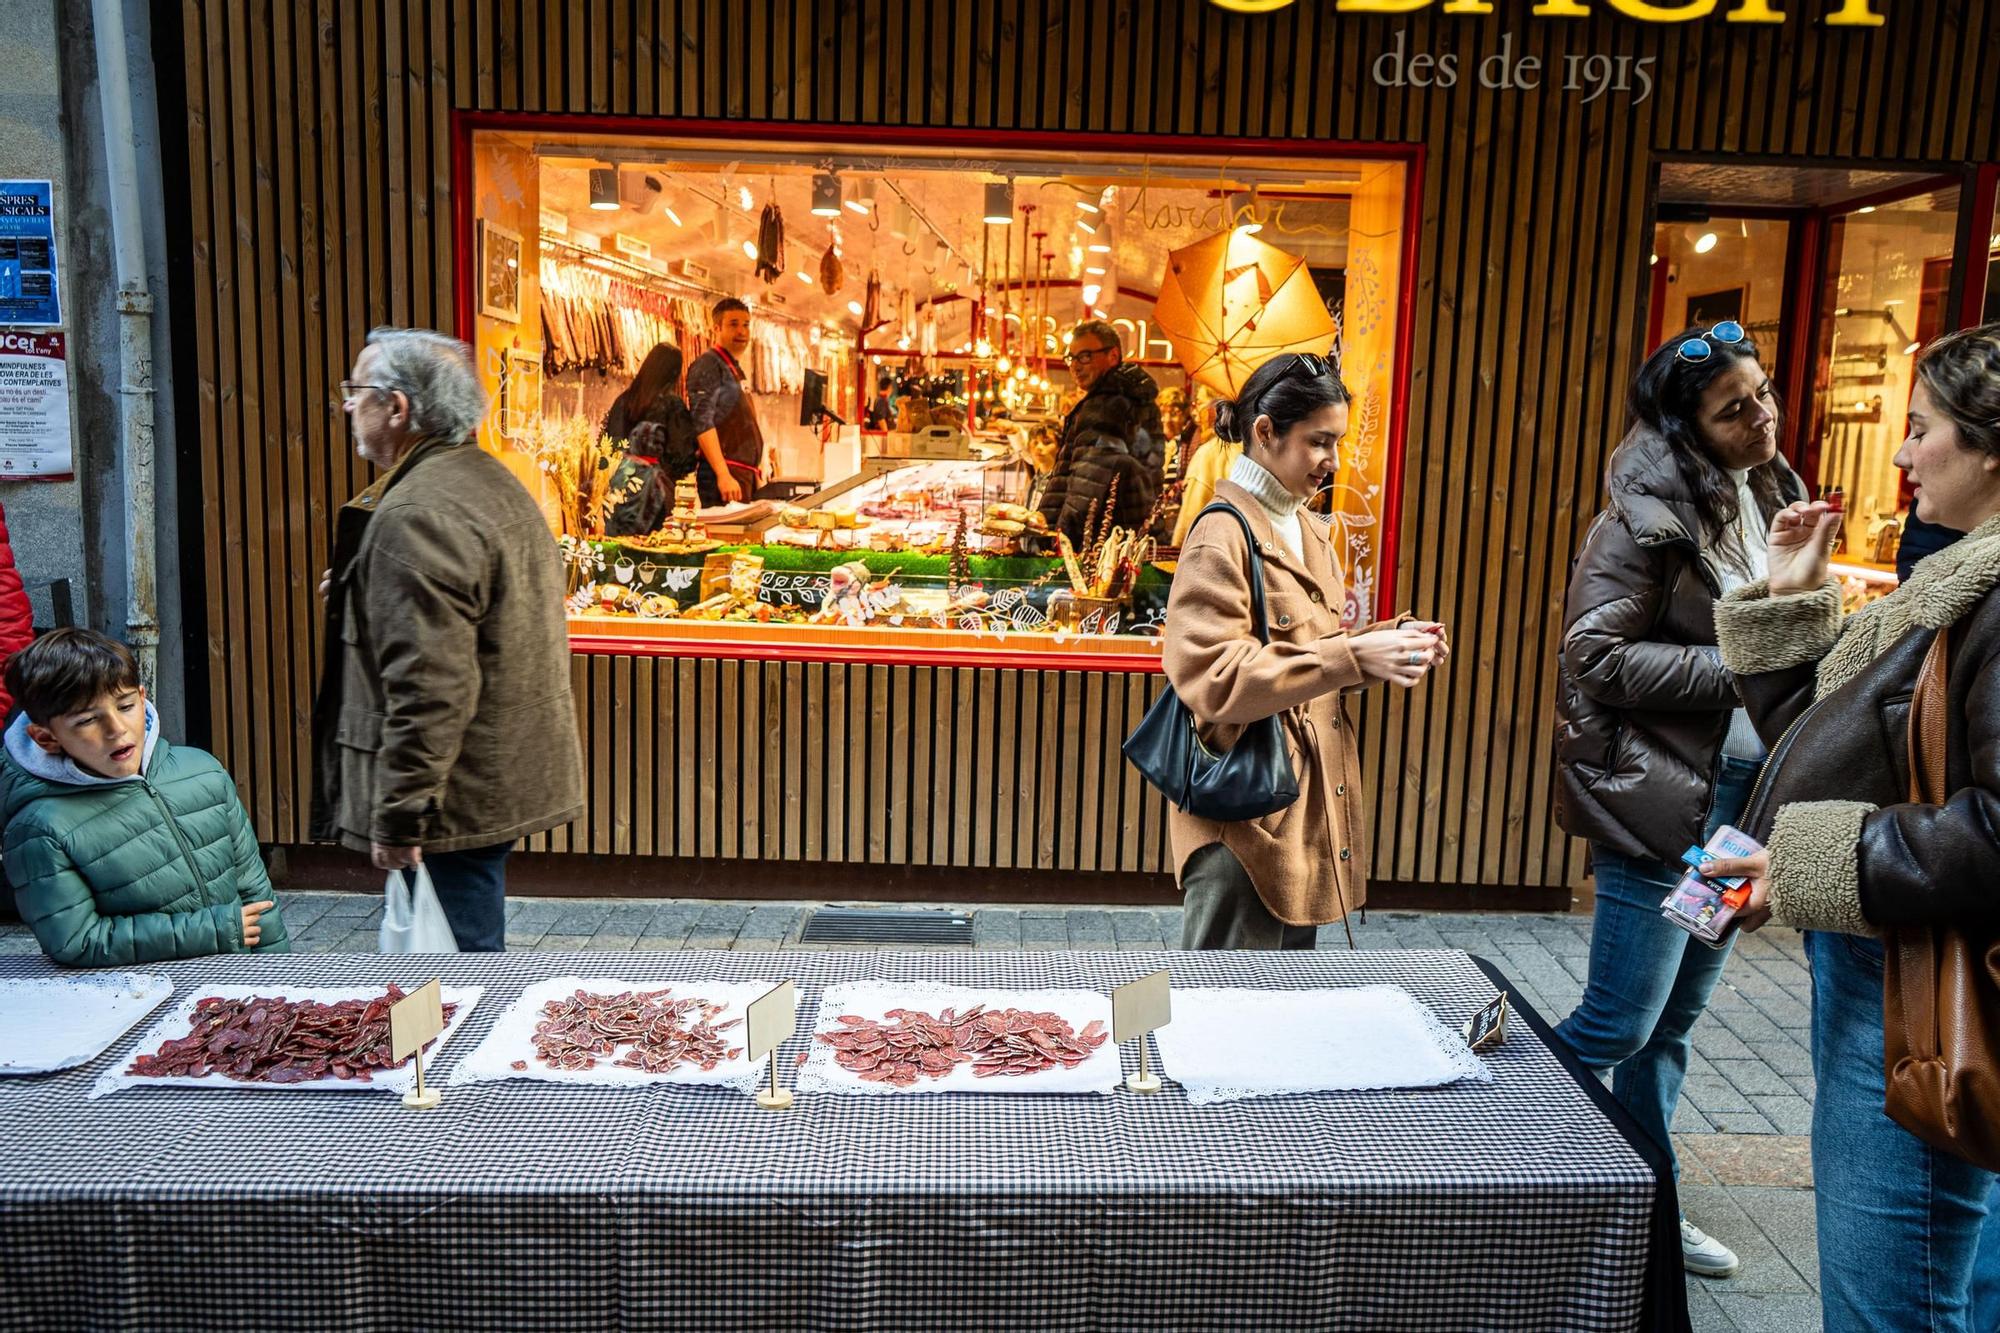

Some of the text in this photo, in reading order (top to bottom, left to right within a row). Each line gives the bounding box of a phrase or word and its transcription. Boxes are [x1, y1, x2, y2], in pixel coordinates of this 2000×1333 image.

[1372, 30, 1656, 105] des de 1915
[40, 371, 53, 379] LES
